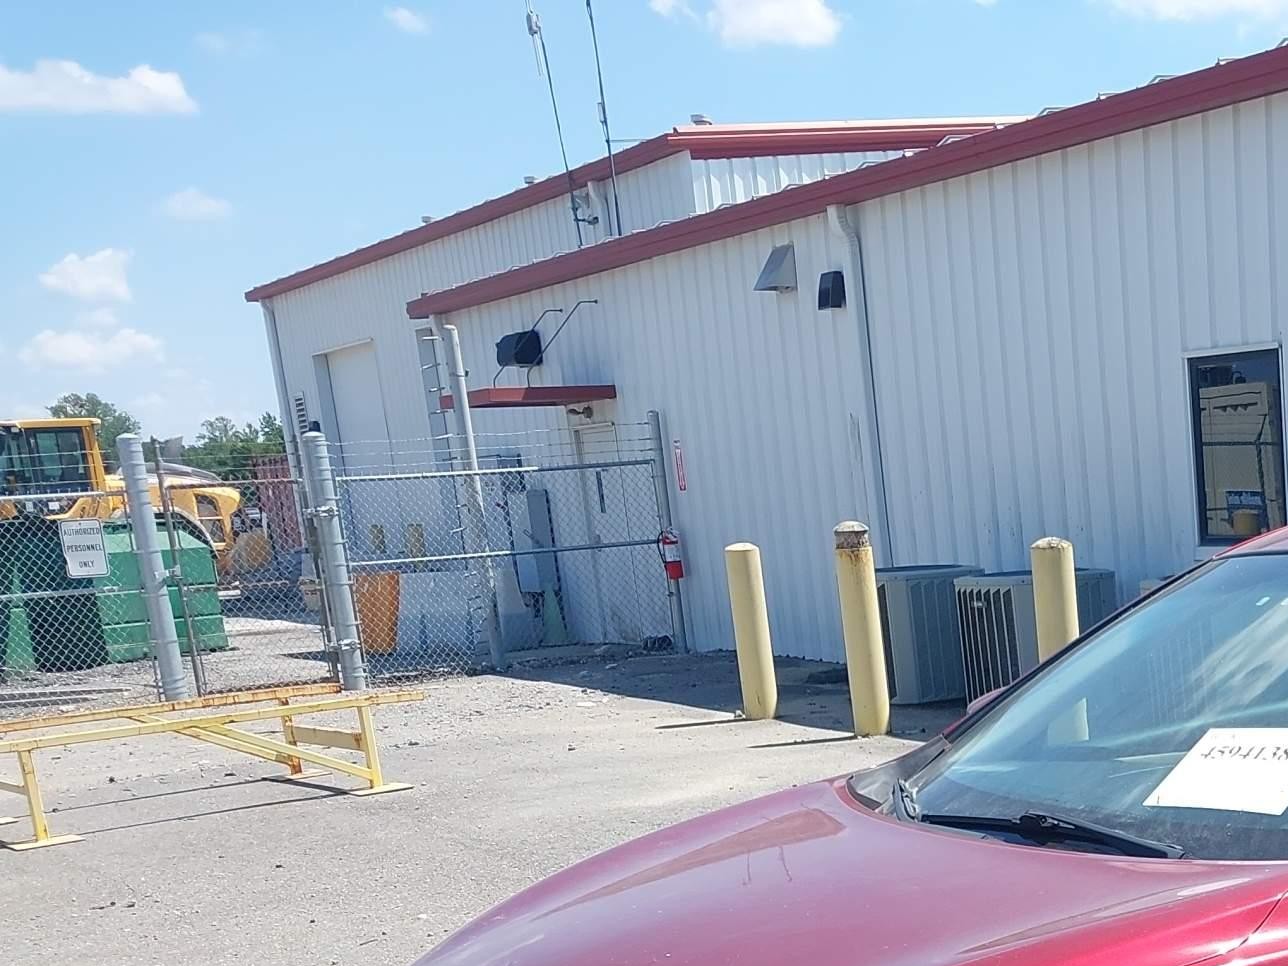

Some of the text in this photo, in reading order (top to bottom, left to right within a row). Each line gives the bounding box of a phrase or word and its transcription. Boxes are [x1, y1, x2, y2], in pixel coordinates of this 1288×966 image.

[63, 527, 100, 537] AUTHORIZED
[66, 543, 103, 553] PERSONNEL
[78, 559, 95, 568] ONLY
